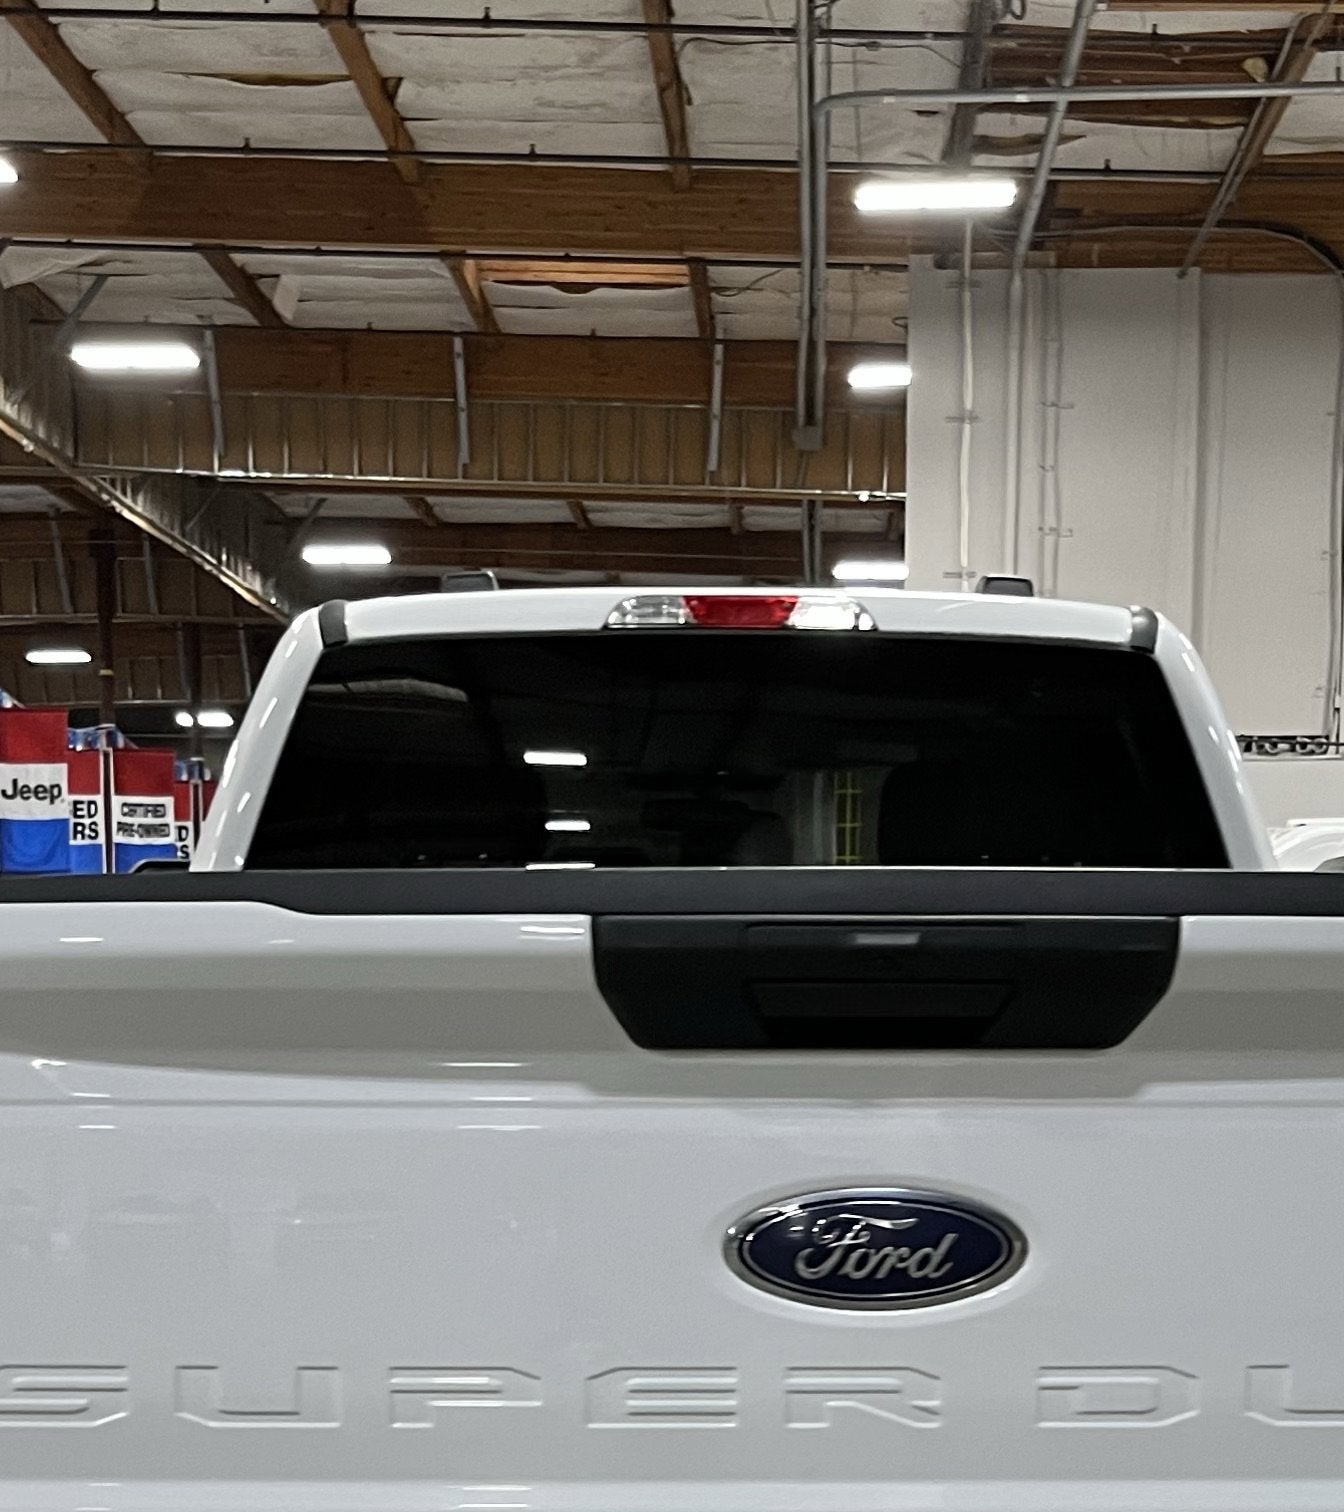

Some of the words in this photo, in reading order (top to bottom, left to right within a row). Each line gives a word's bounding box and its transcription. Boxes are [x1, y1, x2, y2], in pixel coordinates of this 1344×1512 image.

[1, 779, 62, 804] Jeep
[72, 821, 99, 841] RS
[795, 1213, 959, 1280] Ford
